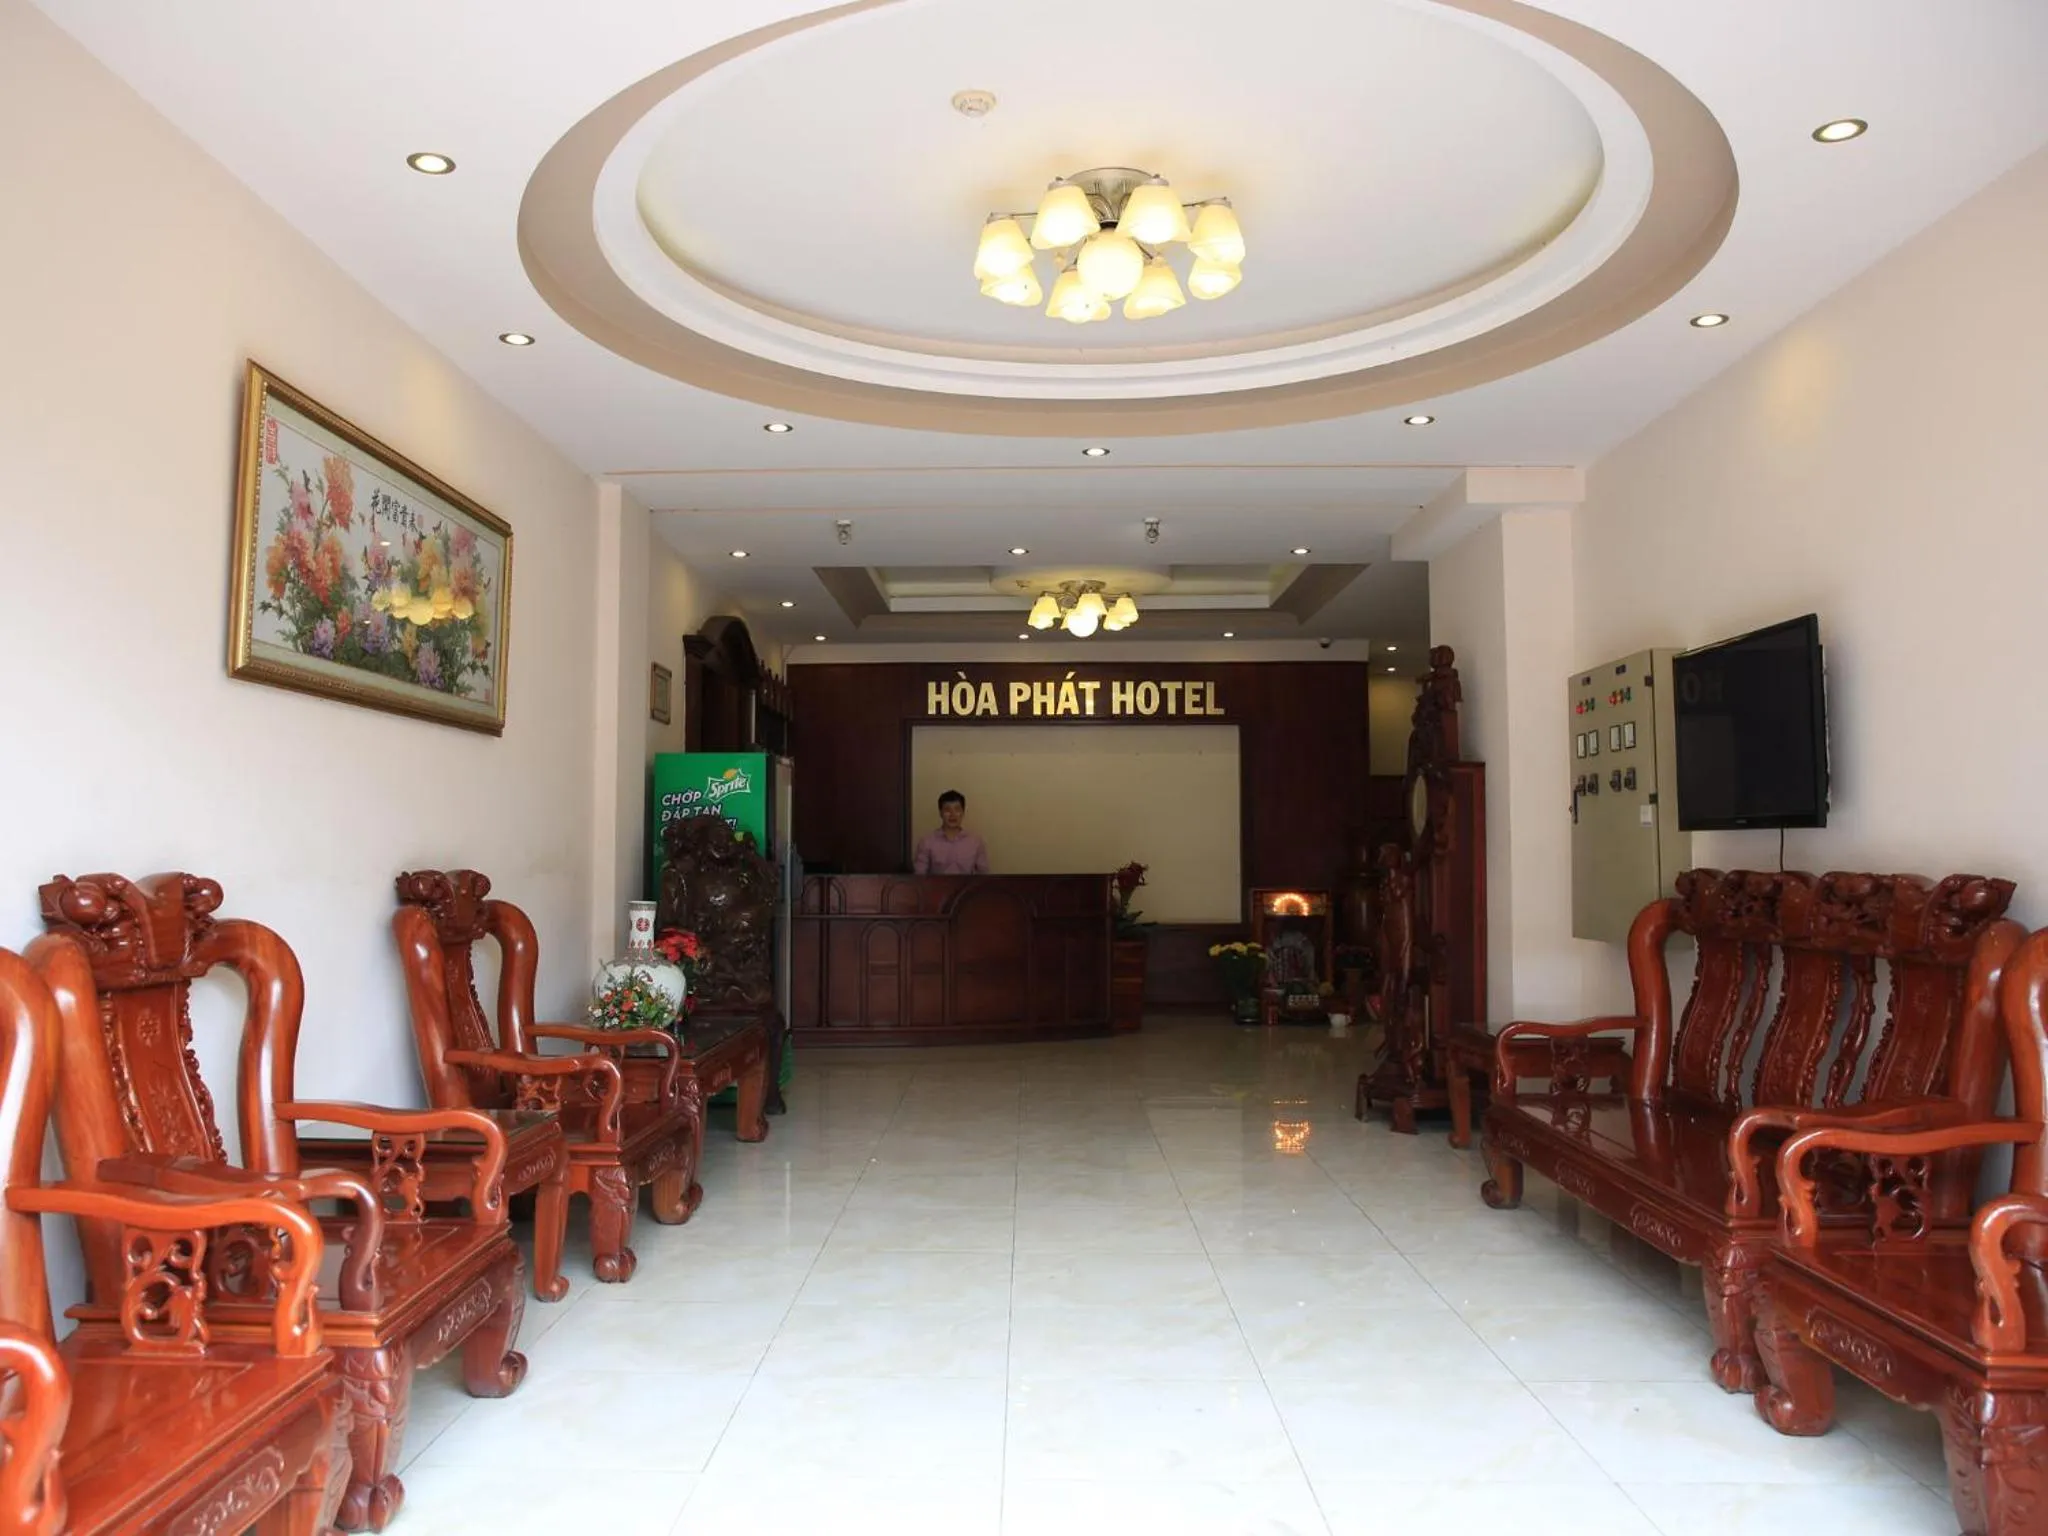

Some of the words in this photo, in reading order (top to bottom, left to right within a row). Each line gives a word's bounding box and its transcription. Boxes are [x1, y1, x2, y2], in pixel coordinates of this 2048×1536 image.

[927, 671, 998, 716] HÒA
[1009, 671, 1101, 716] PHÁT
[1112, 681, 1225, 716] HOTEL
[709, 777, 746, 797] Sprite
[693, 804, 722, 816] TAN
